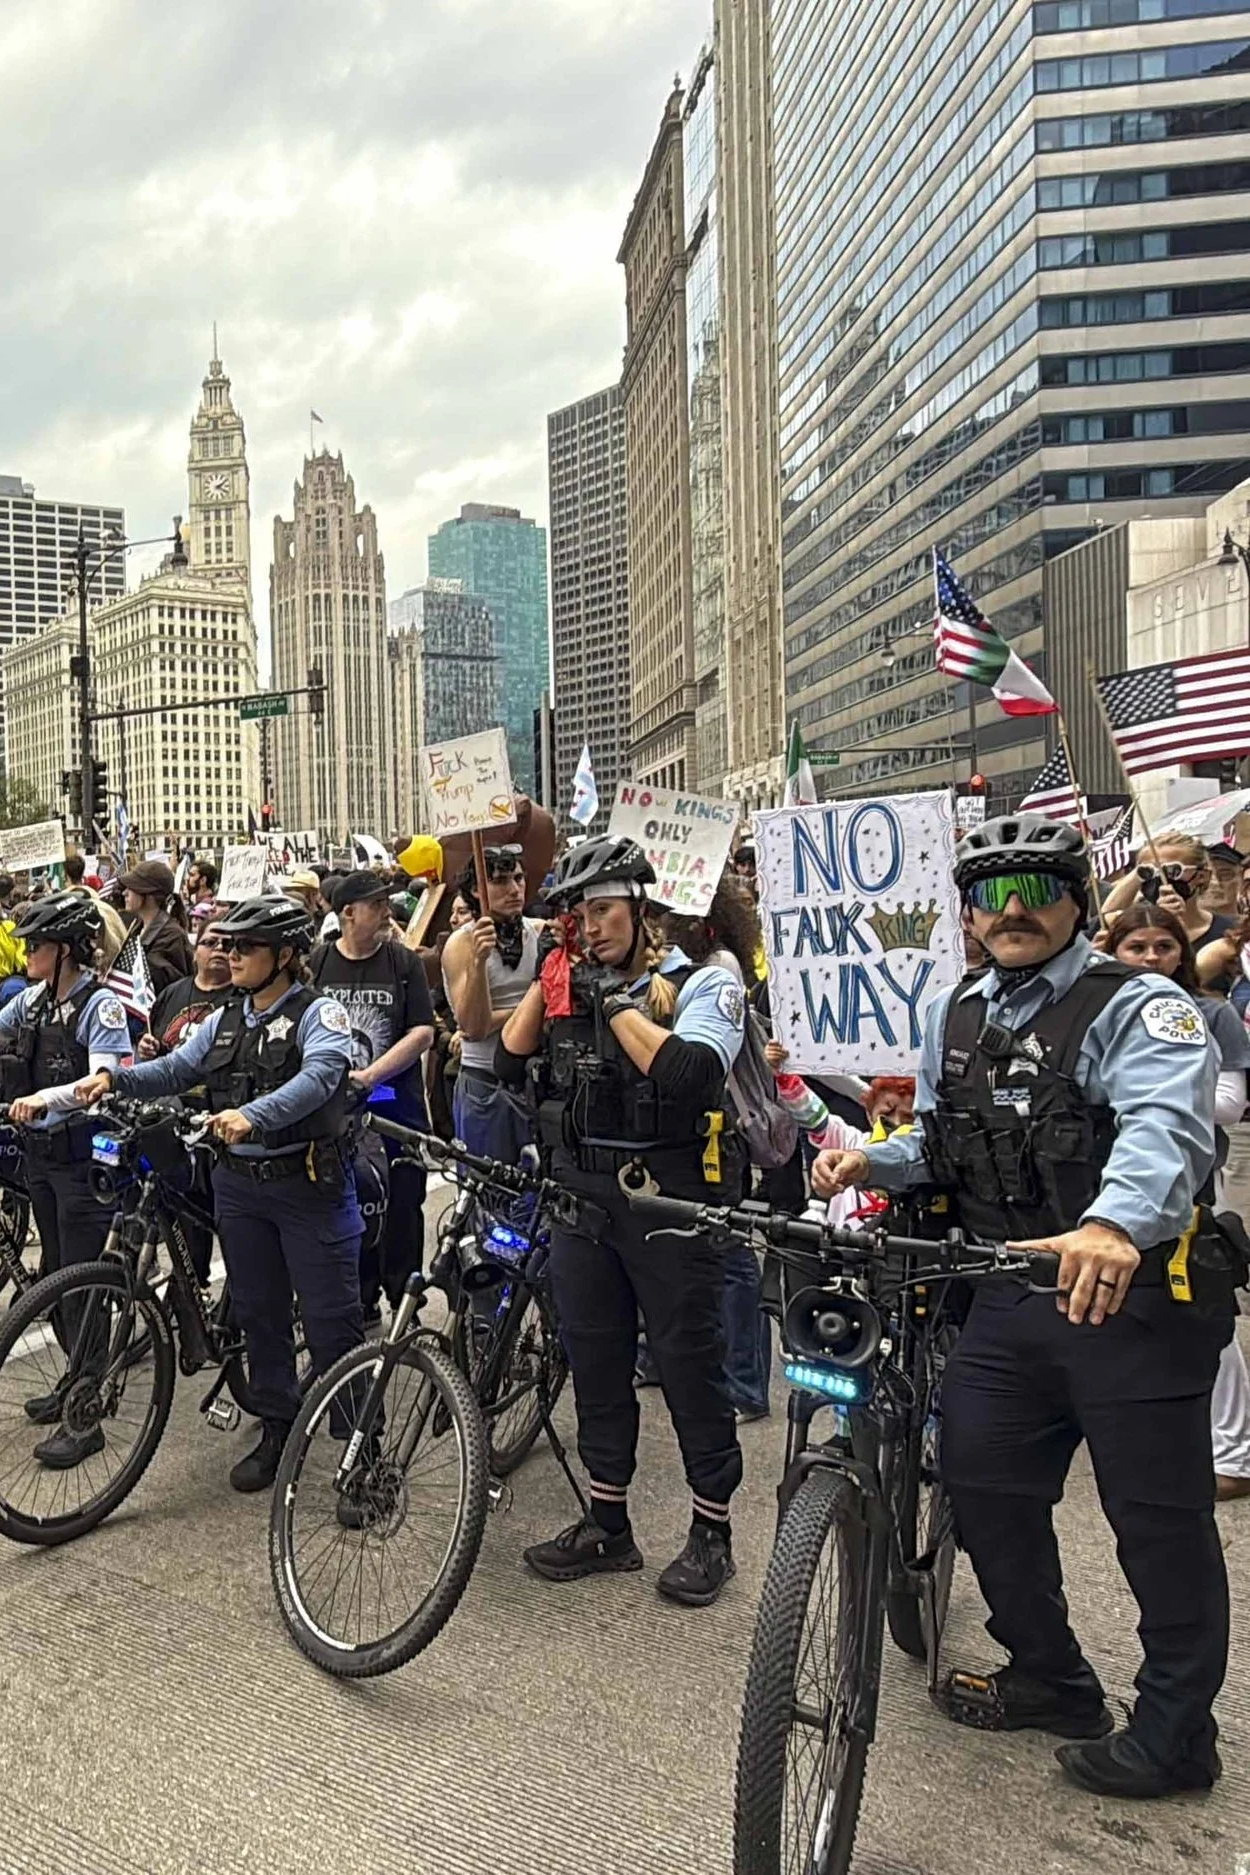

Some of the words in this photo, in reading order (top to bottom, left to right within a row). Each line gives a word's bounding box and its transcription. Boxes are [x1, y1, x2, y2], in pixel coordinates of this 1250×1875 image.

[674, 798, 735, 825] KINGS
[284, 833, 317, 853] ALL
[645, 820, 693, 845] ONLY
[293, 848, 318, 863] THE
[648, 849, 706, 878] MBIA
[791, 803, 905, 898] NO
[267, 863, 296, 877] AME,
[652, 879, 714, 908] INGS
[878, 915, 928, 945] KING
[800, 957, 937, 1051] WAY
[0, 1242, 29, 1284] POLICE
